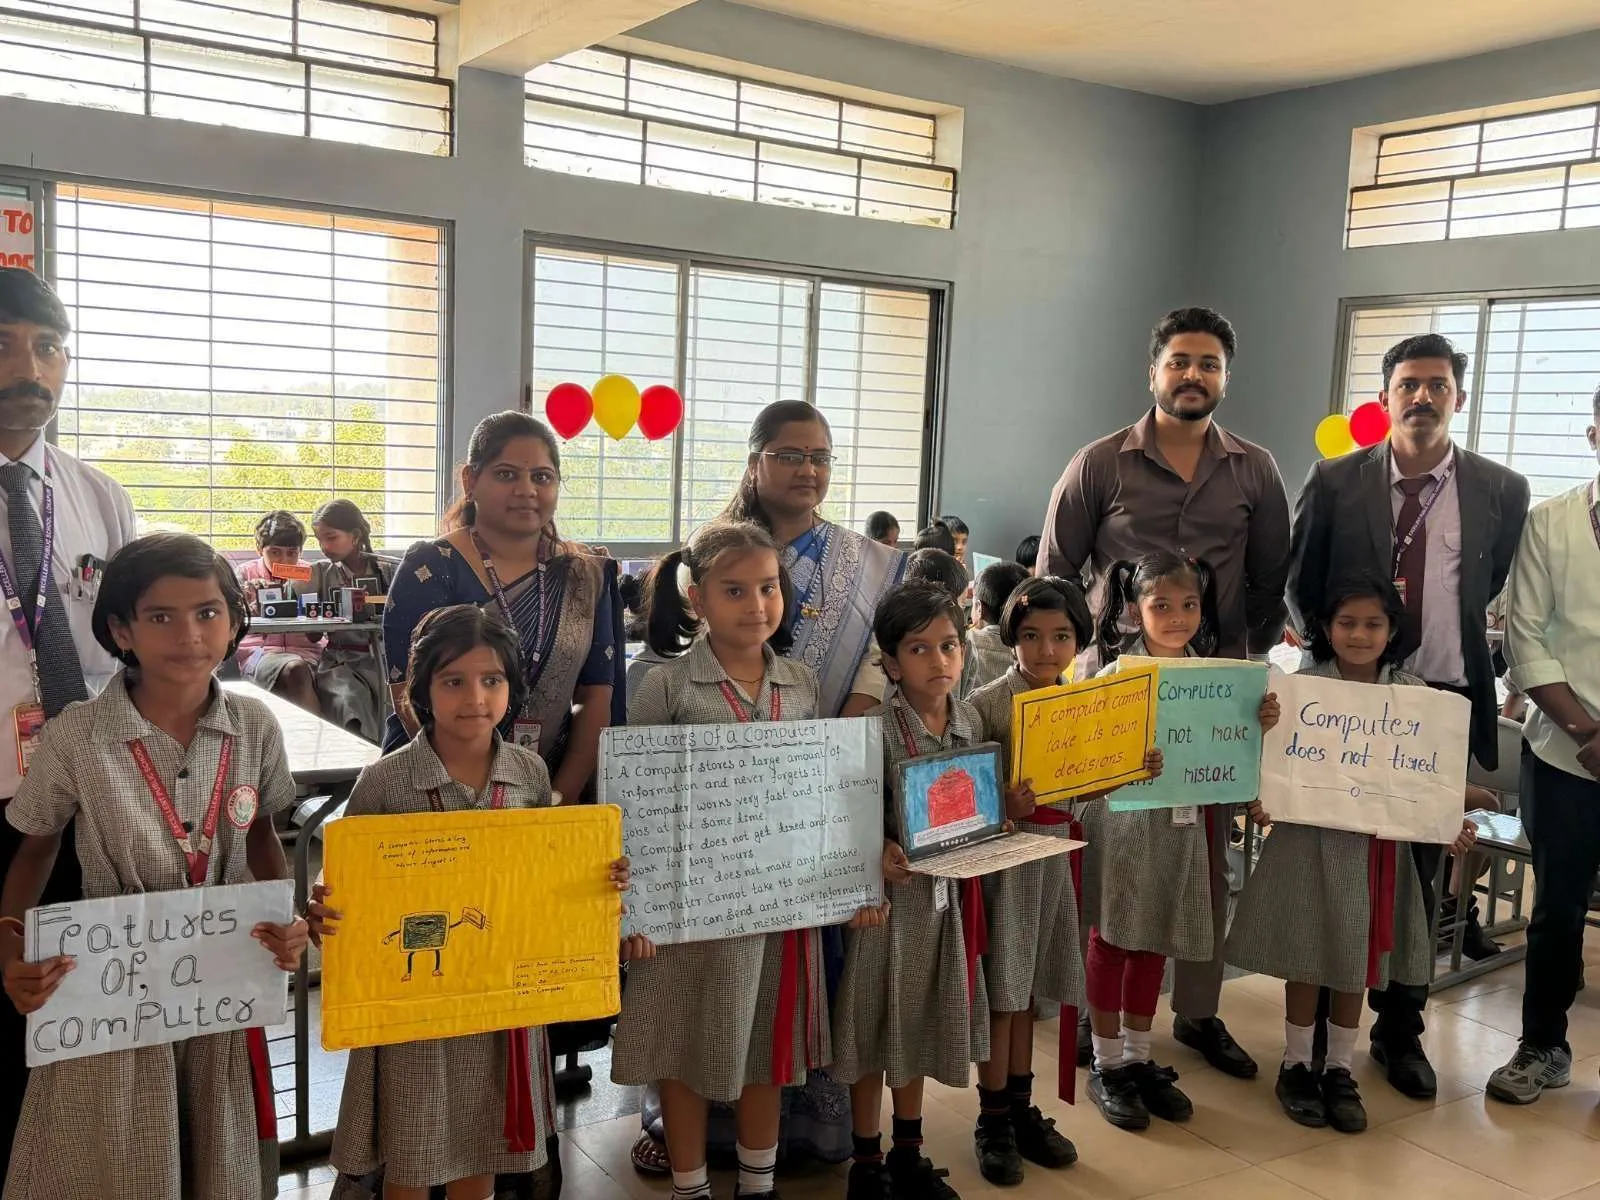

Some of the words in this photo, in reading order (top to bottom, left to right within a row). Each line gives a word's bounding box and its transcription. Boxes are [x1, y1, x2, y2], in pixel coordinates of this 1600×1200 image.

[1028, 706, 1041, 728] A
[1050, 695, 1108, 726] computer
[1111, 688, 1148, 709] cannot
[1300, 701, 1421, 743] Computer
[727, 730, 738, 744] a
[1112, 720, 1138, 737] own
[1168, 725, 1193, 744] not
[1211, 725, 1249, 742] make
[618, 766, 629, 779] A
[697, 759, 735, 773] stores
[739, 760, 747, 768] a
[788, 748, 825, 763] amount
[830, 745, 840, 760] of
[1285, 732, 1328, 762] does
[1341, 742, 1374, 768] not
[1388, 744, 1438, 774] tired
[622, 783, 698, 801] information
[705, 778, 728, 789] and
[734, 775, 763, 785] never
[1183, 765, 1237, 784] mistake
[623, 808, 631, 819] A
[697, 799, 732, 811] works
[736, 793, 759, 807] very
[765, 788, 788, 804] fast
[792, 784, 813, 798] and
[838, 779, 850, 790] do
[853, 777, 879, 794] many
[624, 845, 634, 857] A
[701, 839, 728, 850] does
[732, 831, 749, 843] not
[754, 825, 772, 843] get
[779, 820, 806, 833] tired
[809, 815, 828, 828] and
[832, 815, 850, 824] can
[657, 822, 670, 834] at
[677, 821, 694, 831] the
[701, 817, 732, 829] same
[630, 885, 639, 896] A
[714, 870, 742, 883] does
[744, 863, 762, 877] not
[766, 860, 793, 872] make
[796, 855, 816, 871] any
[667, 858, 681, 871] for
[689, 856, 713, 869] long
[629, 904, 638, 917] A
[752, 883, 773, 894] take
[797, 875, 817, 885] own
[760, 898, 779, 911] and
[819, 883, 873, 899] information
[33, 906, 237, 963] Features
[171, 954, 202, 987] a
